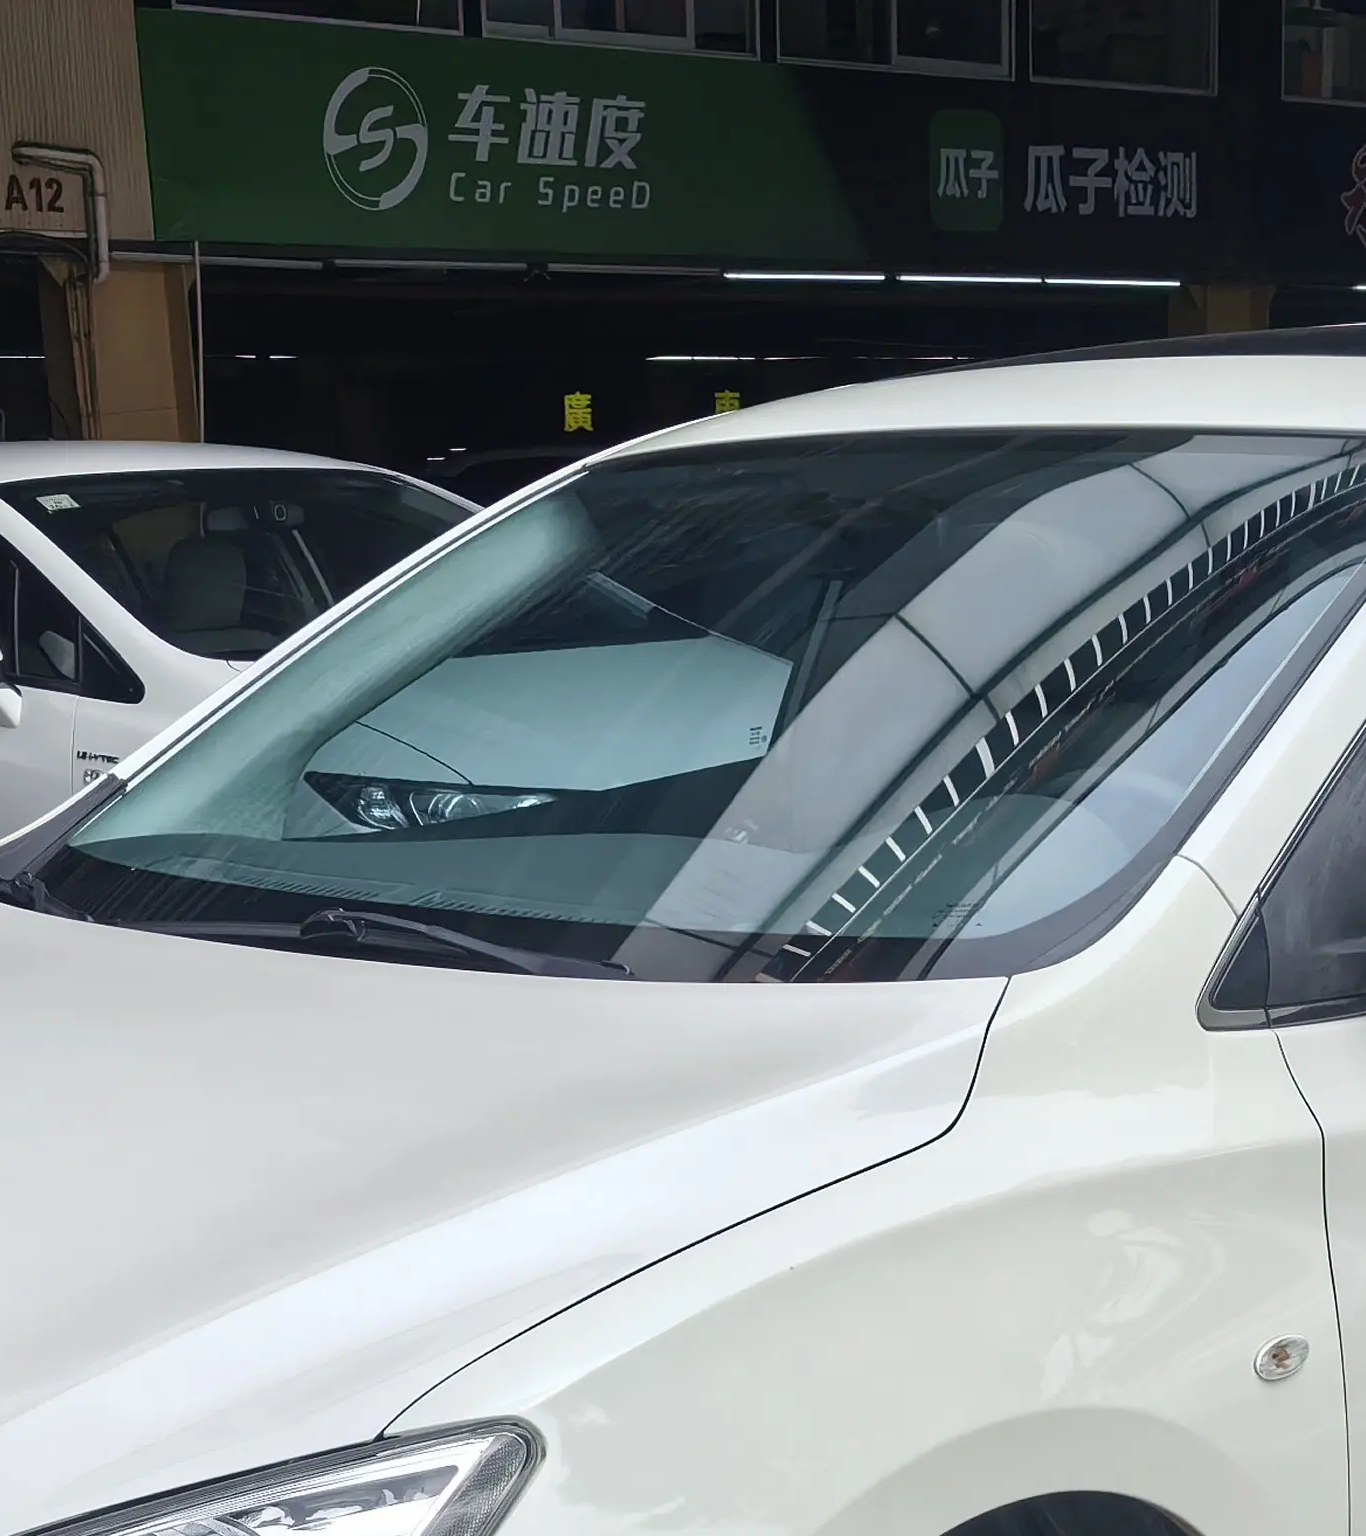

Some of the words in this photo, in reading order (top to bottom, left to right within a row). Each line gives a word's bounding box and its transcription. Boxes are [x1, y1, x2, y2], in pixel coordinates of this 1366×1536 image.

[447, 84, 648, 171] 车速度
[4, 174, 65, 214] A12
[448, 171, 513, 205] Car
[938, 147, 1000, 199] 瓜子
[1024, 143, 1198, 220] 瓜子检测
